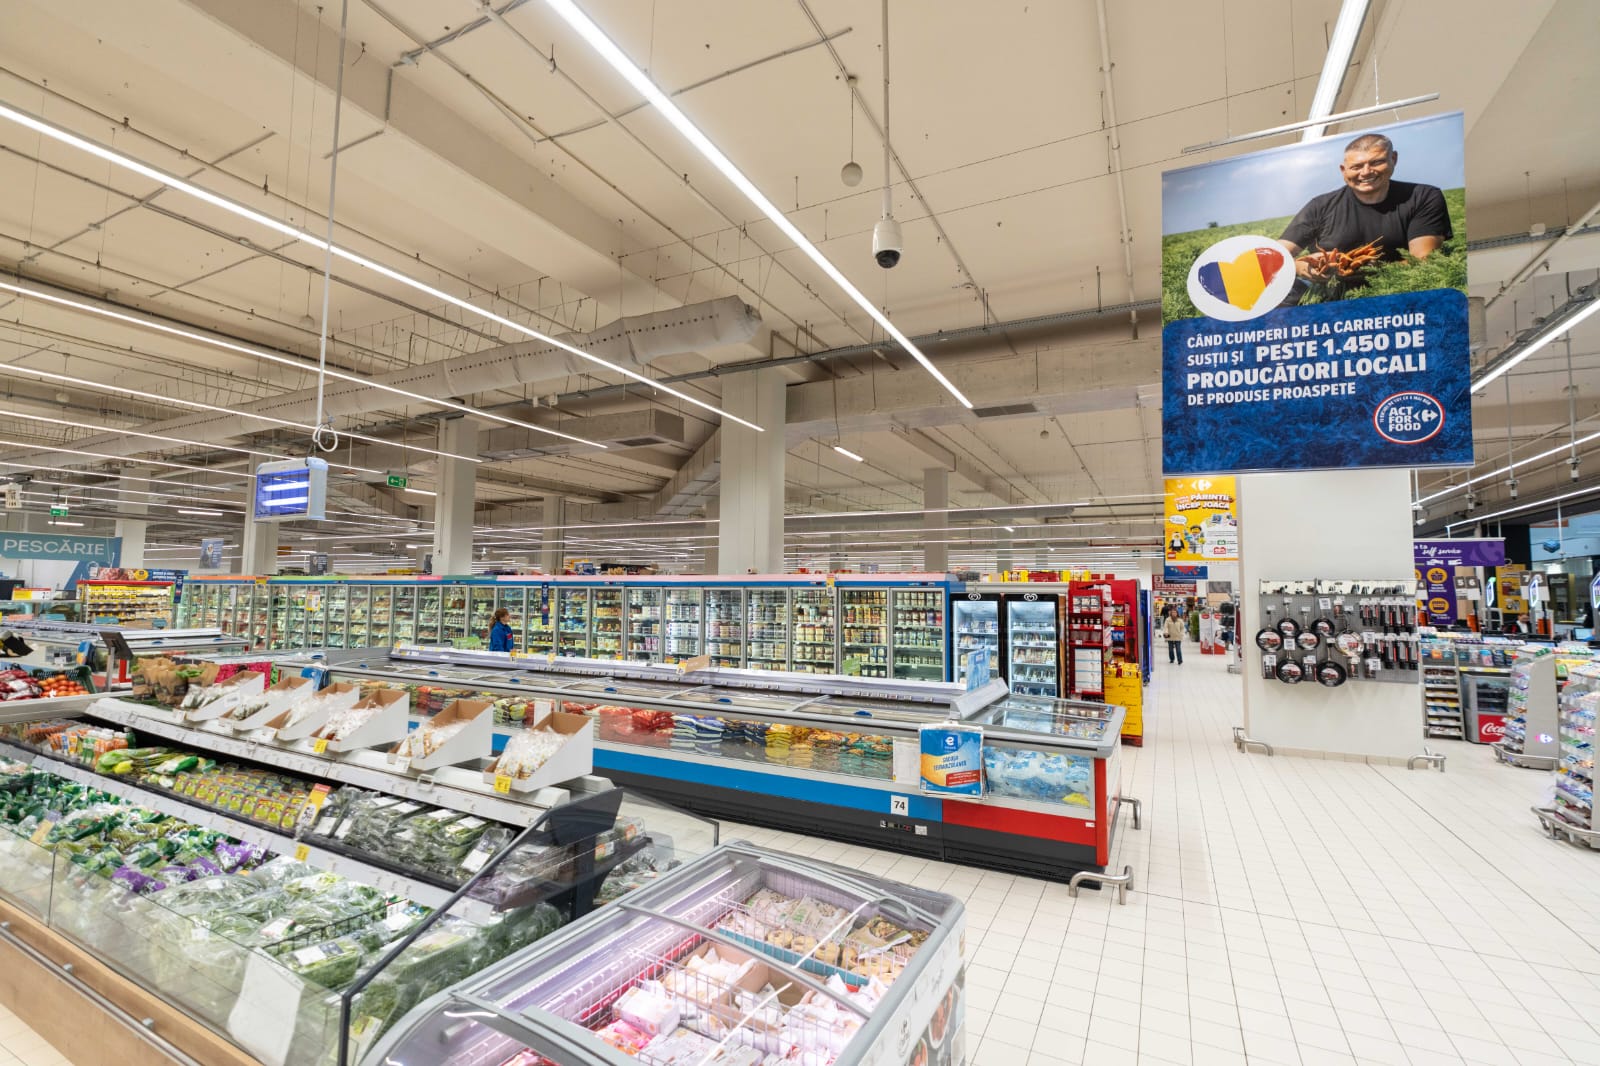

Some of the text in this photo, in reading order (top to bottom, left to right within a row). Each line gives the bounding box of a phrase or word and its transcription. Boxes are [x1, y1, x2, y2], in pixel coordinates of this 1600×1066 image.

[1187, 313, 1425, 348] CÂND CUMPERI DE LA CARREFOUR
[1256, 340, 1318, 362] PESTE
[1322, 333, 1390, 355] 1.450
[1395, 330, 1425, 349] DE
[1187, 353, 1426, 389] PRODUCĂTORI LOCALI
[1188, 382, 1356, 406] DE PRODUSE PROASPETE
[1389, 406, 1413, 416] ACT
[1388, 415, 1412, 424] FOR
[1388, 423, 1421, 432] FOOD
[3, 538, 105, 555] PESCĂRIE
[1522, 574, 1530, 583] 7
[893, 800, 905, 810] 74
